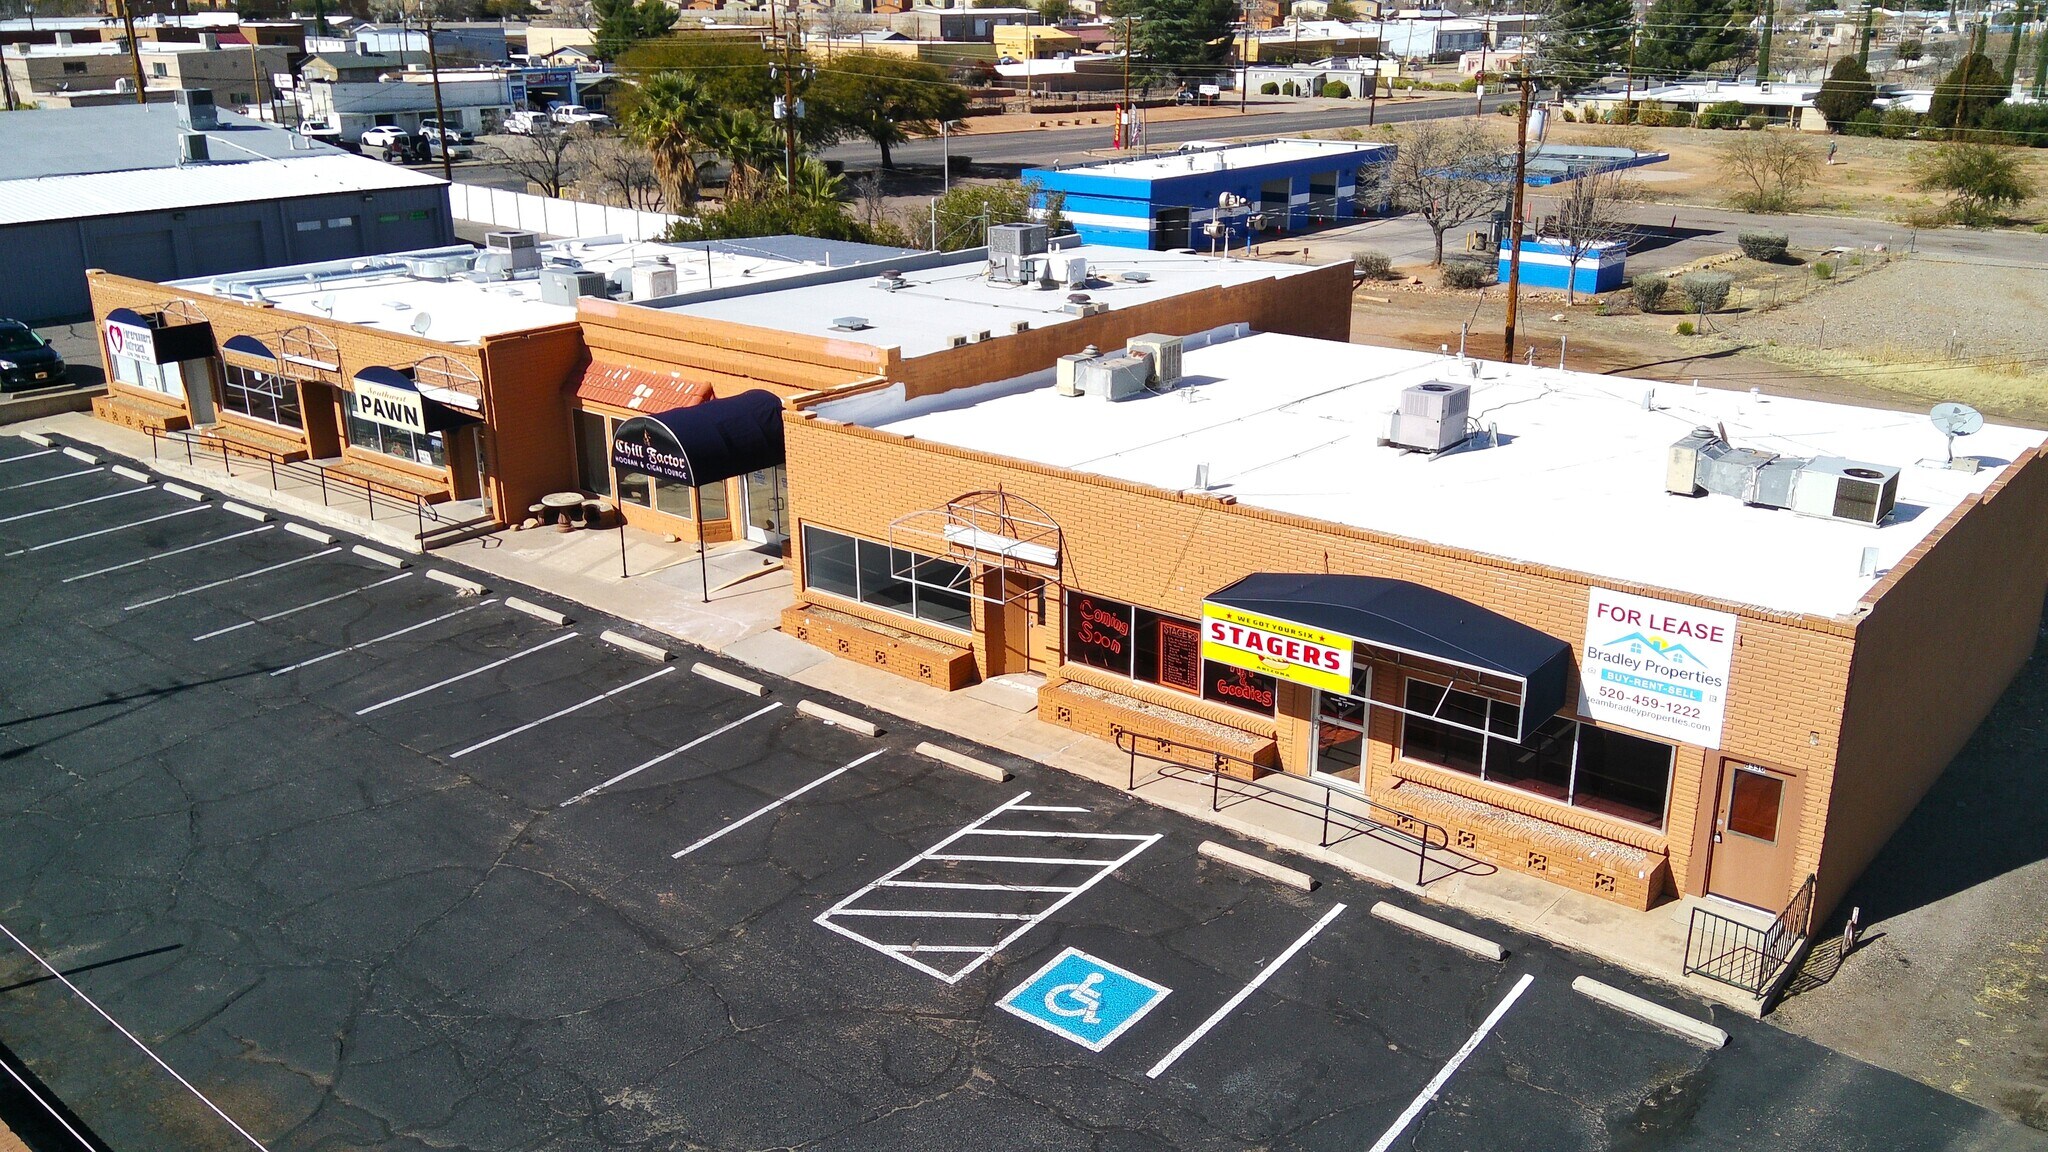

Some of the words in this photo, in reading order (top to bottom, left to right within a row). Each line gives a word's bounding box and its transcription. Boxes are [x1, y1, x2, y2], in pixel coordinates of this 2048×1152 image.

[367, 387, 406, 402] Southwest
[361, 394, 419, 427] PAWN
[615, 438, 644, 458] Chill
[647, 447, 685, 468] Factor
[615, 456, 638, 467] HOOKAH
[647, 463, 662, 474] CIGAR
[664, 468, 687, 479] LOUNGE
[1080, 599, 1129, 637] Coming
[1163, 624, 1198, 642] STAGERS
[1237, 615, 1251, 623] WE
[1253, 620, 1269, 628] GOT
[1272, 624, 1296, 634] YOUR
[1298, 630, 1313, 639] SIX
[1597, 602, 1642, 627] FOR
[1649, 614, 1725, 643] LEASE
[1078, 620, 1121, 654] Soon
[1211, 622, 1340, 670] STAGERS
[1256, 665, 1290, 677] ARIZONA
[1587, 646, 1641, 671] Bradley
[1645, 659, 1722, 687] Properties
[1217, 679, 1272, 707] Goodies
[1607, 671, 1697, 700] BUY-RENT-SELL
[1587, 695, 1711, 732] teambradleyproperties.com
[1599, 686, 1700, 719] 520-459-1222
